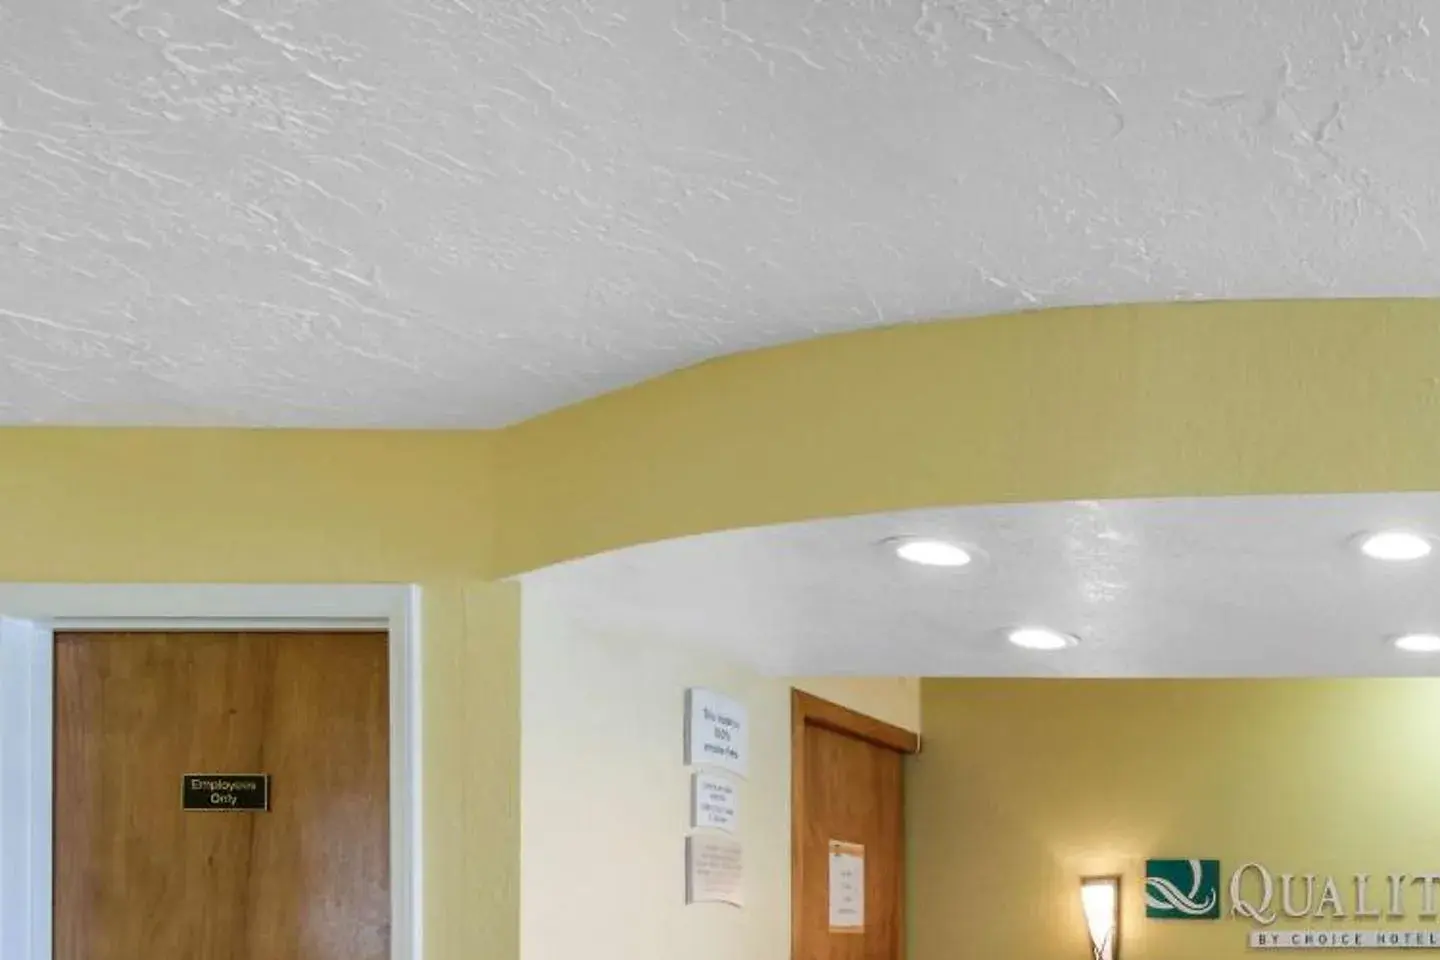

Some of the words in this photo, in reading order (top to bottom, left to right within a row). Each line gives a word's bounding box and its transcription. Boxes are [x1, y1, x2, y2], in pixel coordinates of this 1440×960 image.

[191, 779, 256, 791] Employees
[210, 793, 237, 805] Only
[1258, 932, 1279, 945] BY
[1291, 932, 1362, 945] CHOICE
